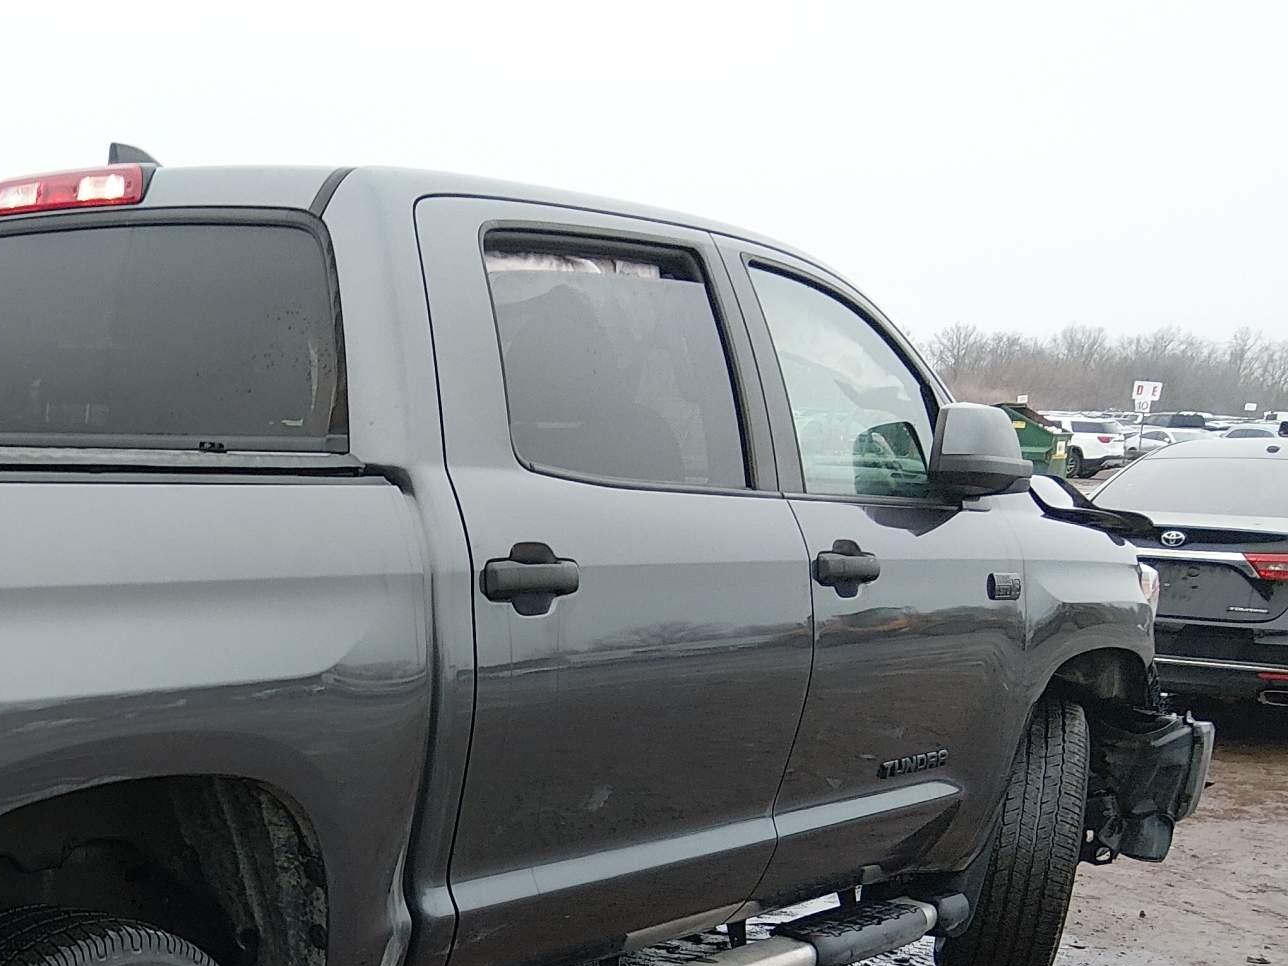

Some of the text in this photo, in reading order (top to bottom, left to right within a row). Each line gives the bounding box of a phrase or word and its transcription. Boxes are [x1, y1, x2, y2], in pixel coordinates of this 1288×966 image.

[1152, 386, 1158, 396] E
[1137, 401, 1149, 410] 10
[880, 749, 949, 777] TUNDRA
